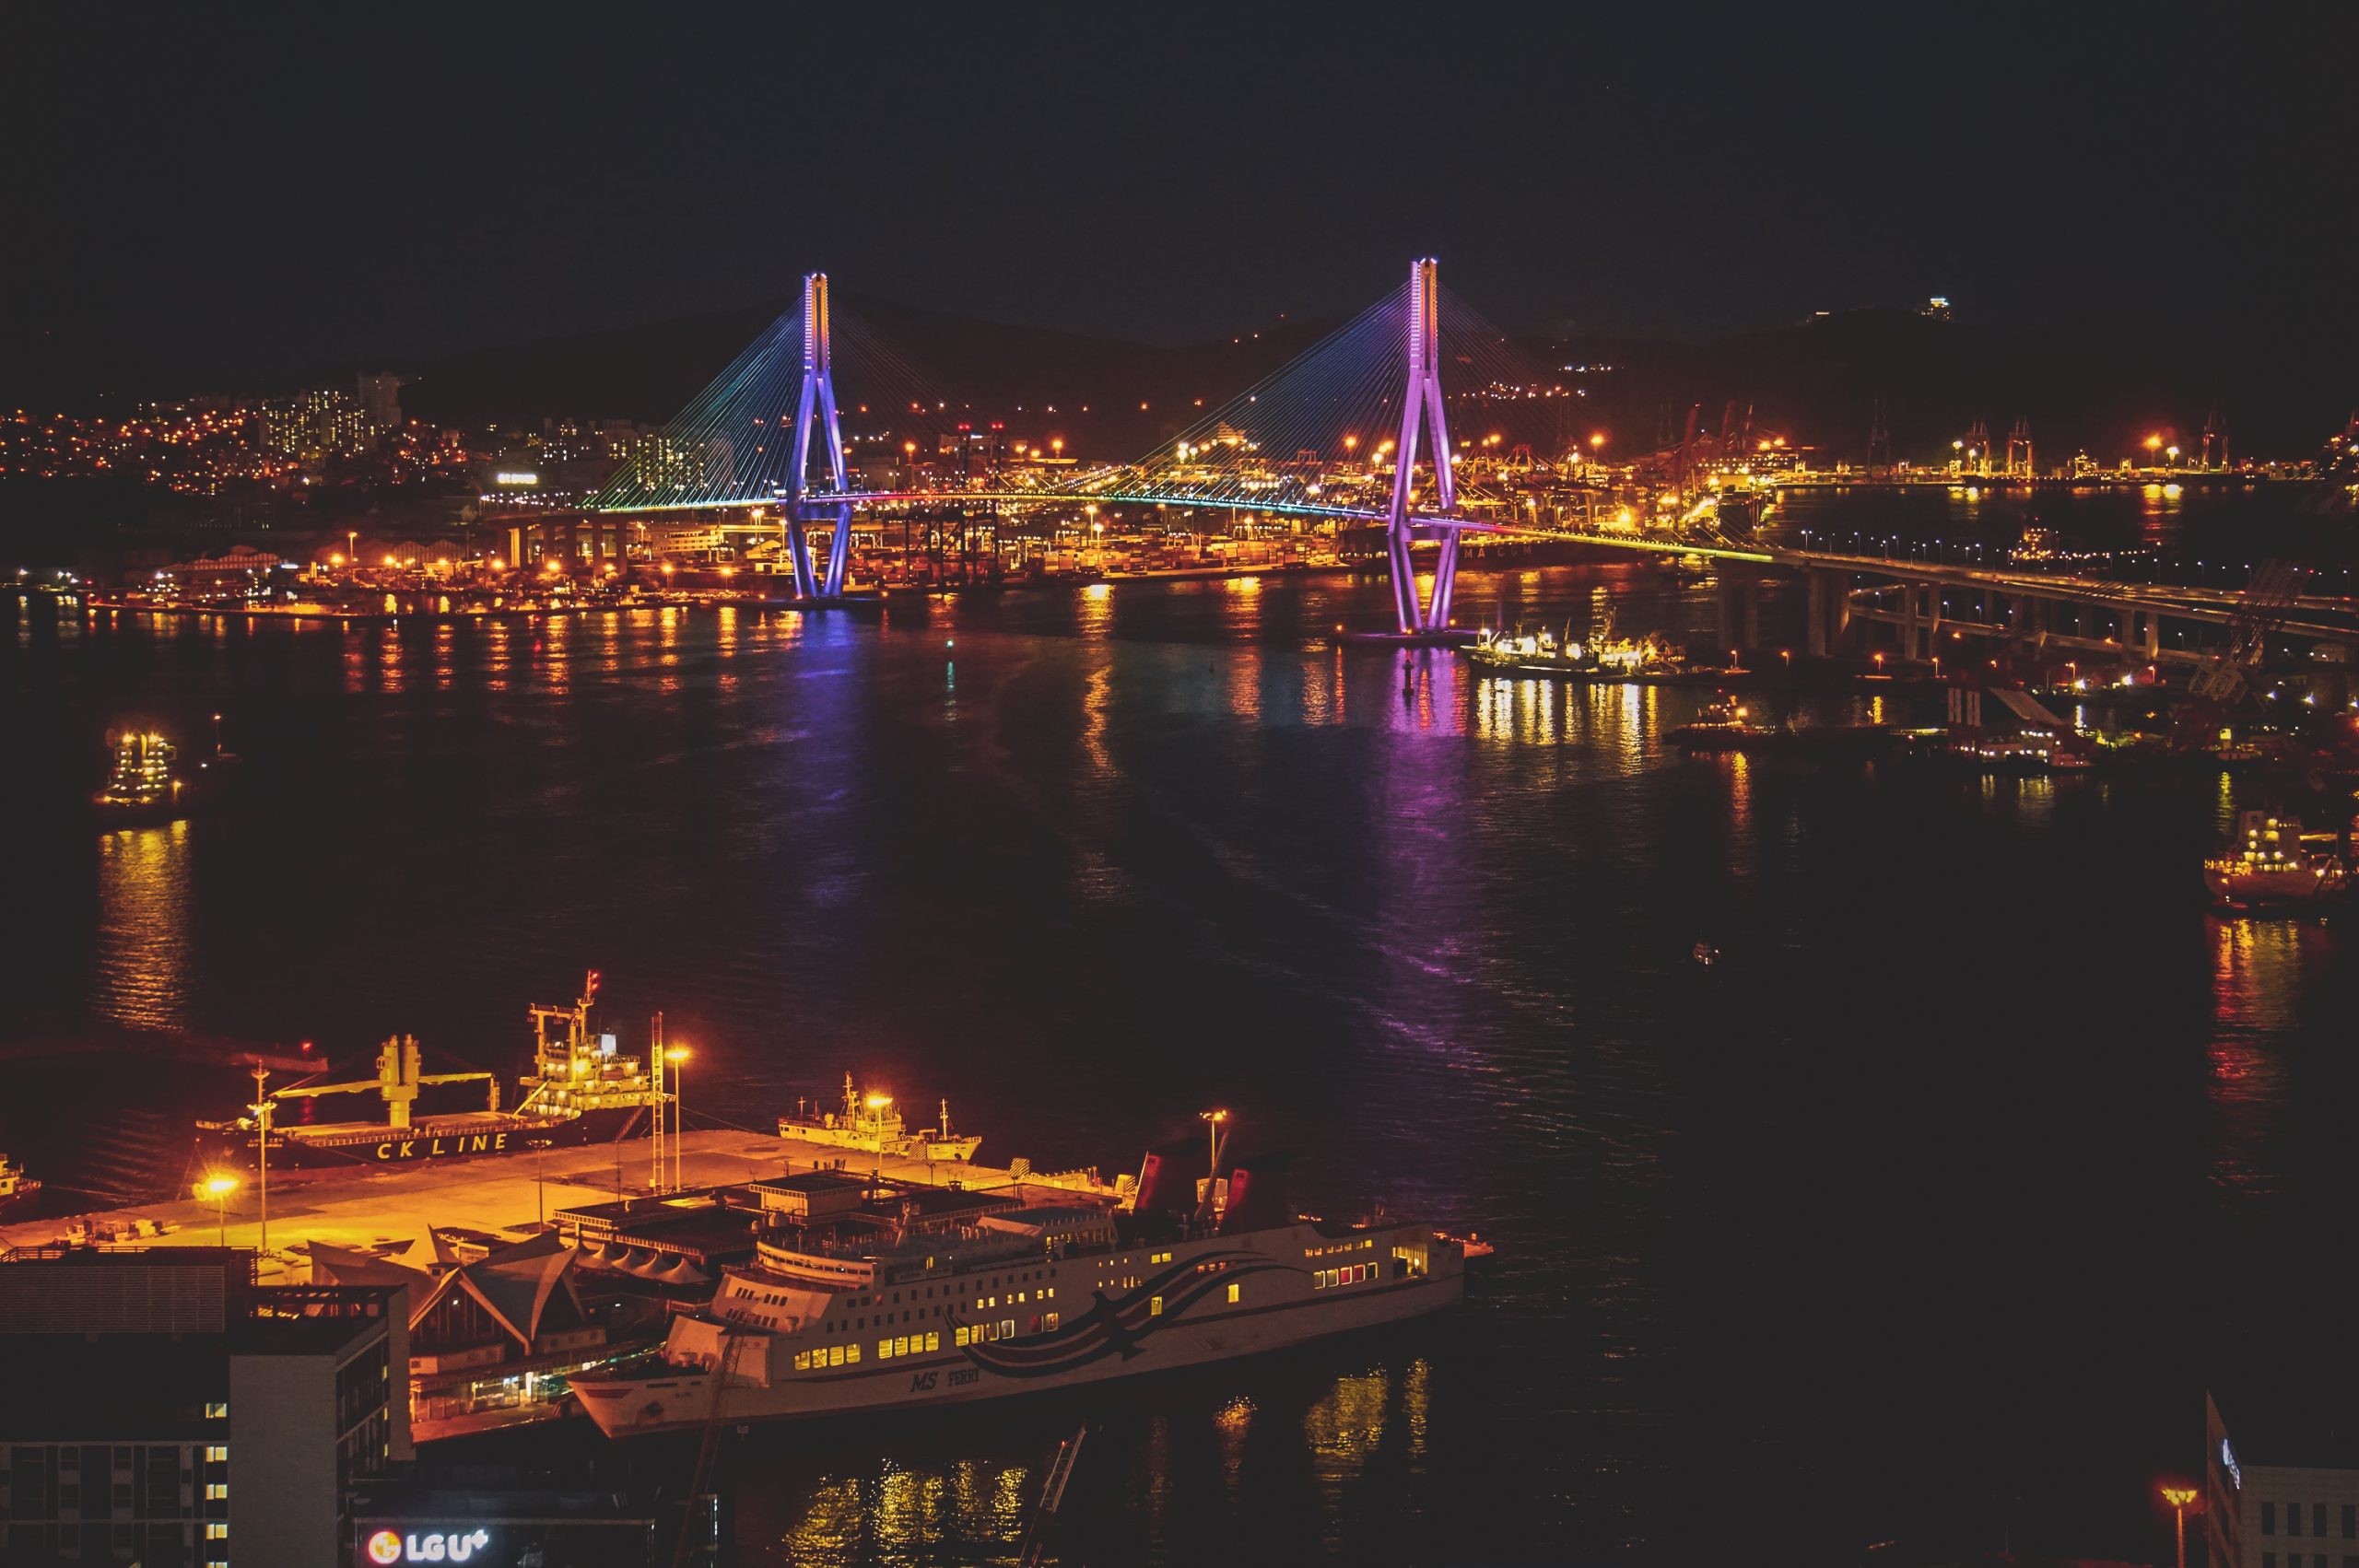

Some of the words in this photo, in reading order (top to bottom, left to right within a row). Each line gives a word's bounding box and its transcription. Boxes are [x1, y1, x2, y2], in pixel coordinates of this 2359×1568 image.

[1464, 547, 1485, 558] MA
[377, 1141, 414, 1159] CK
[432, 1133, 507, 1155] LINE
[910, 1371, 939, 1392] MS
[947, 1367, 980, 1387] FERRY
